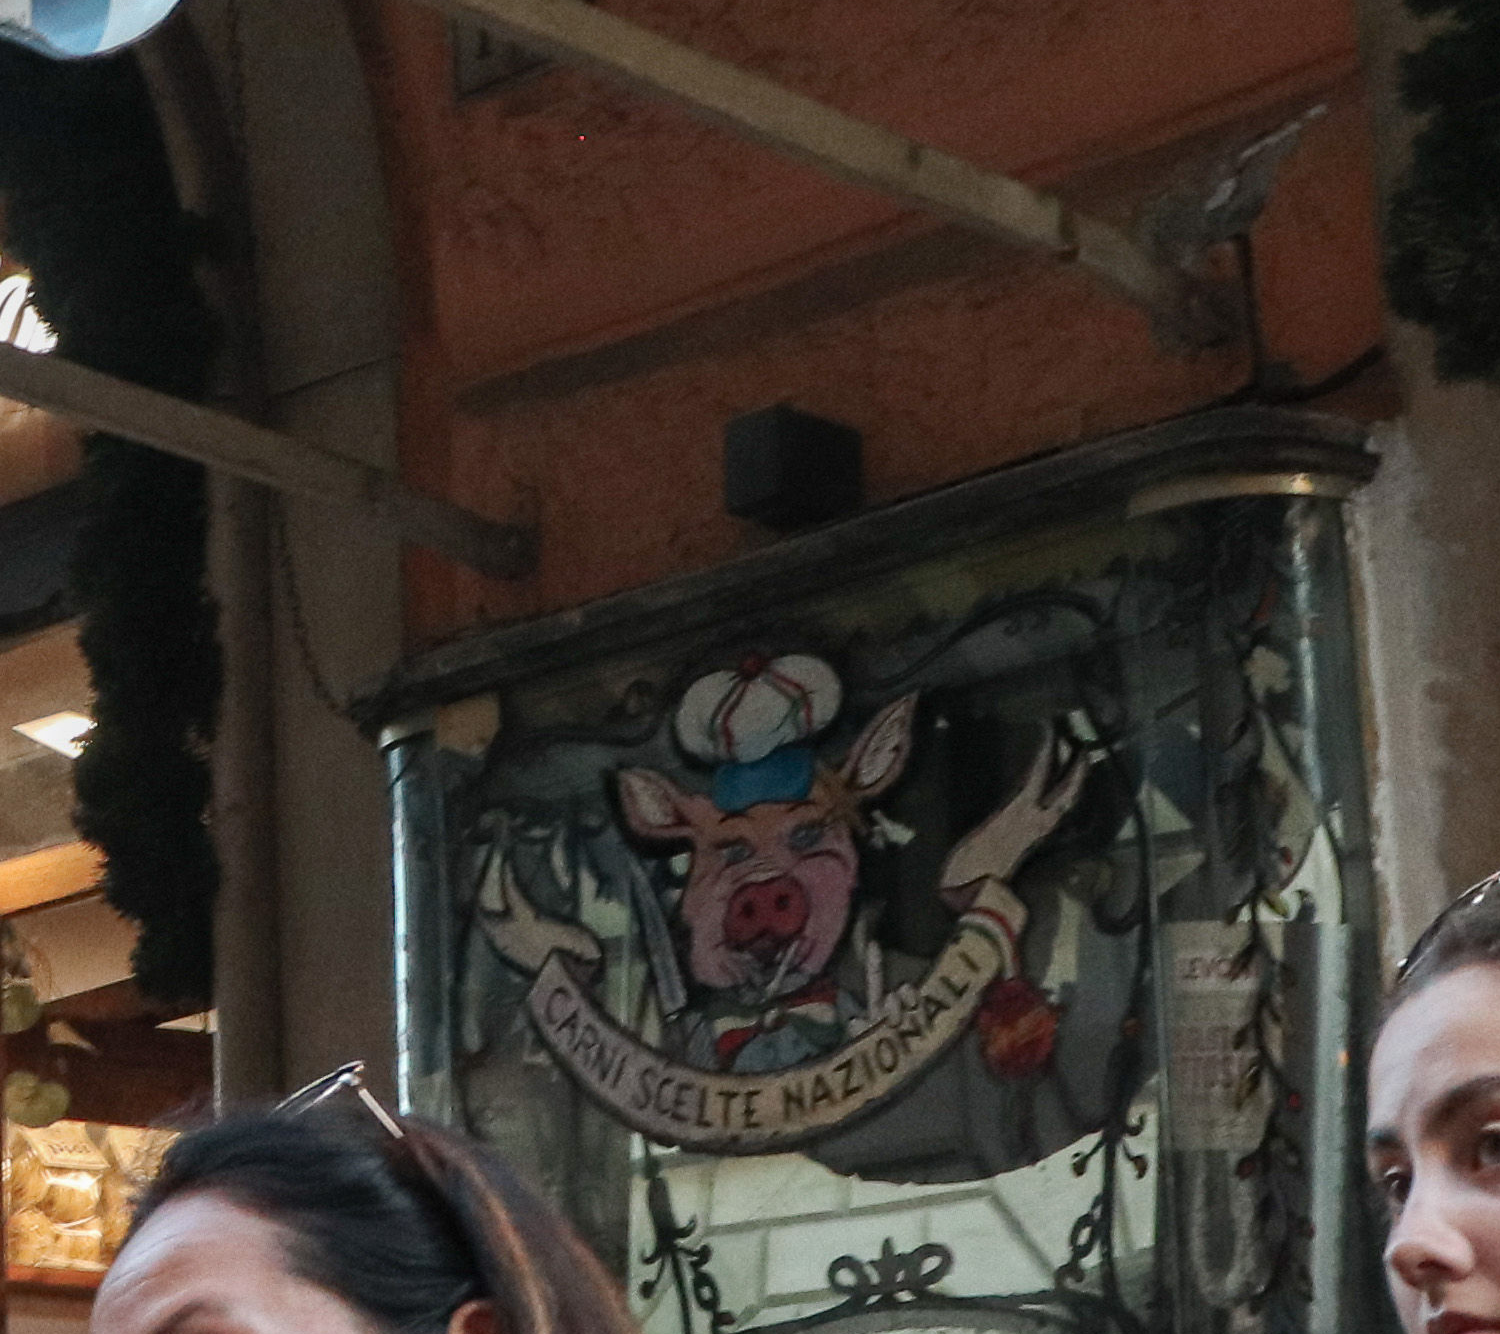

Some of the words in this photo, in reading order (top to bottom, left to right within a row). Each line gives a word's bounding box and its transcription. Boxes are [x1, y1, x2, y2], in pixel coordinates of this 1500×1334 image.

[543, 985, 627, 1092] CARNI
[632, 1067, 762, 1128] SCELTE
[783, 950, 979, 1122] NAZIONALI
